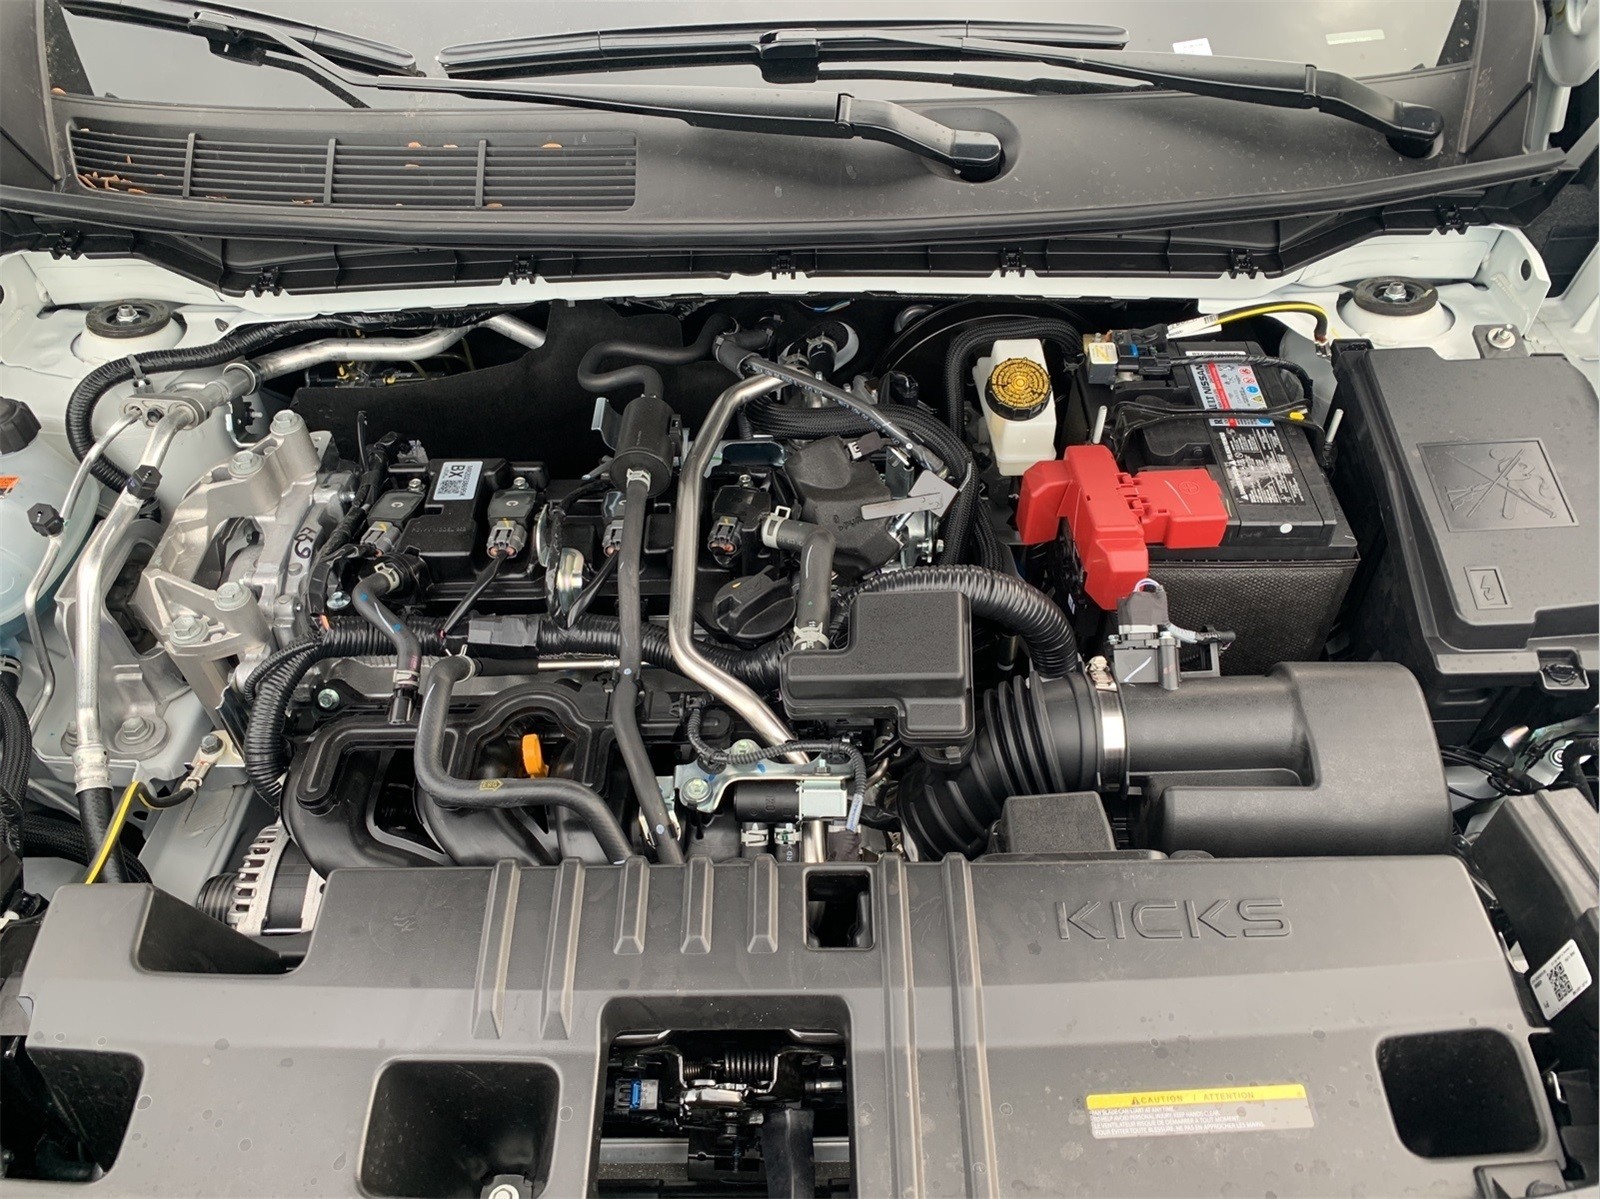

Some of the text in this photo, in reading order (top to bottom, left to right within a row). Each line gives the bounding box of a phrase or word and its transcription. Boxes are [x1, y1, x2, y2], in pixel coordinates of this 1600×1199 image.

[1195, 363, 1213, 395] NISSAN
[449, 465, 466, 478] BX
[1054, 898, 1292, 939] KICKS
[1140, 1095, 1183, 1105] CAUTION
[1204, 1091, 1254, 1101] ATTENTION
